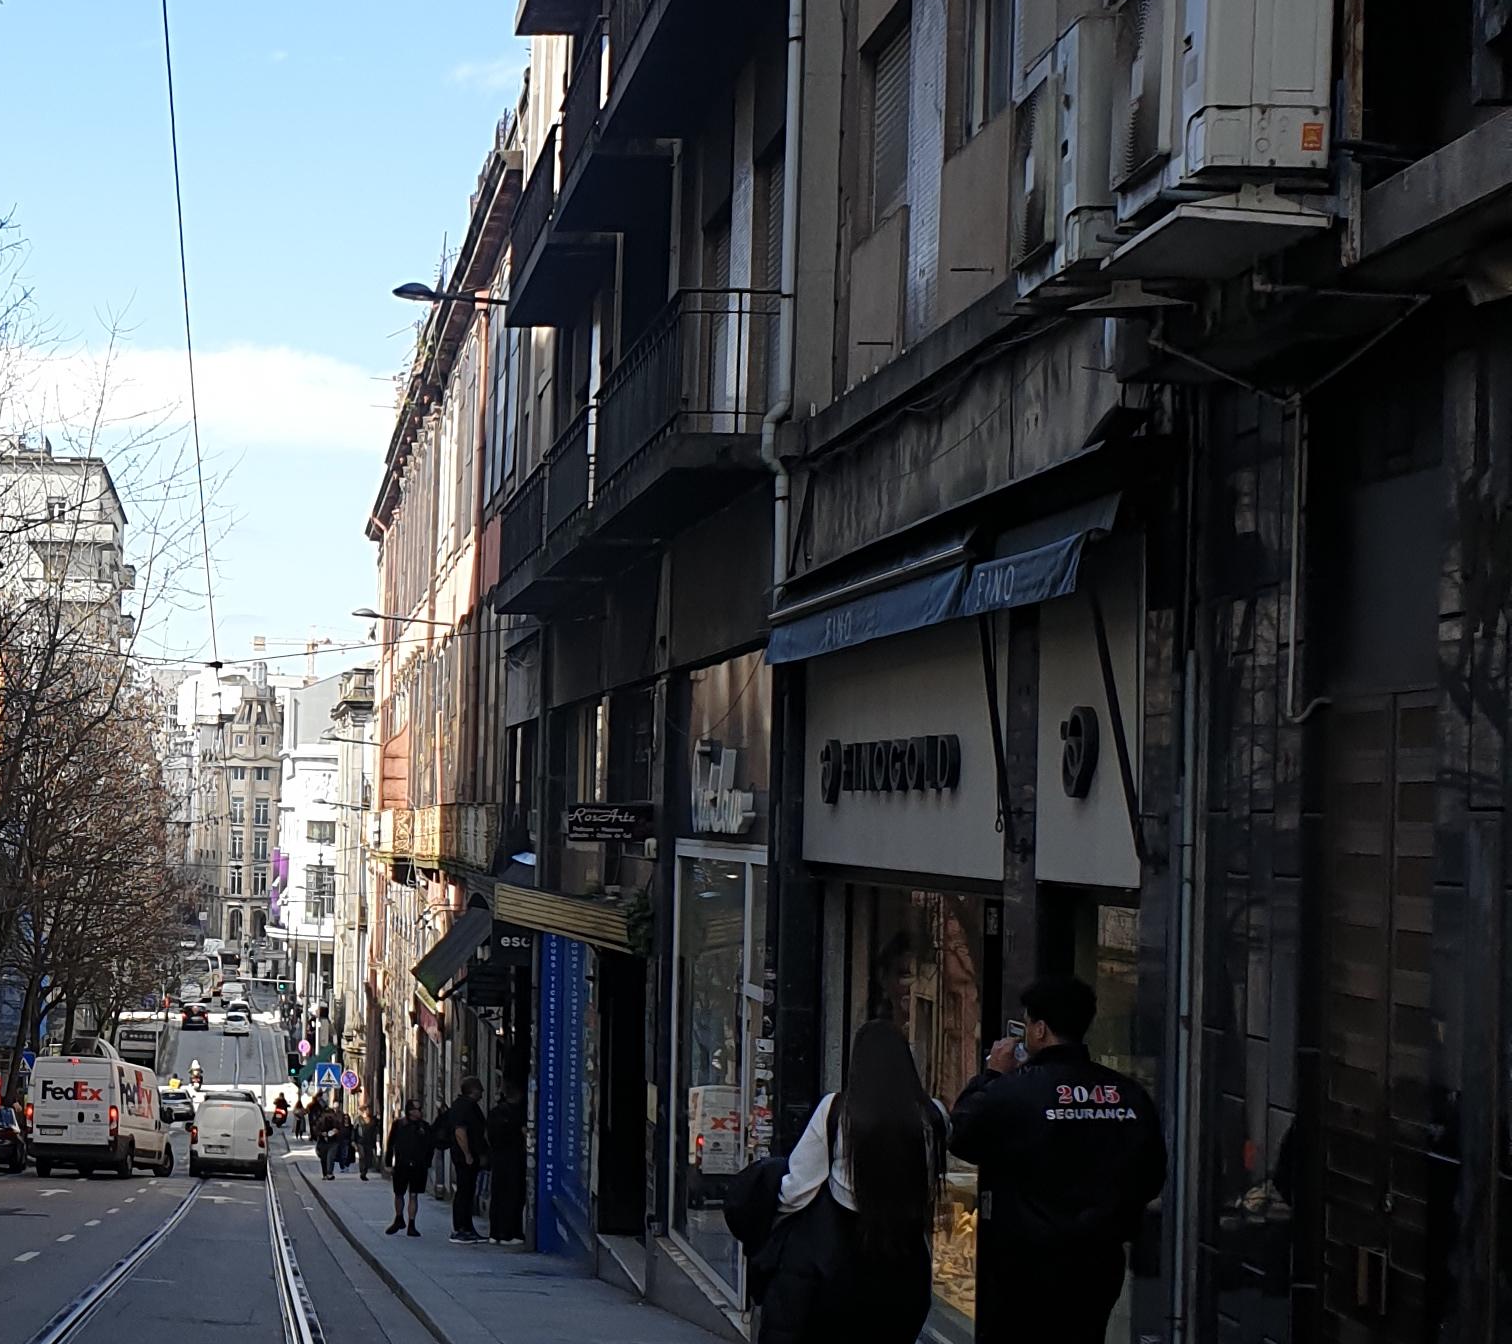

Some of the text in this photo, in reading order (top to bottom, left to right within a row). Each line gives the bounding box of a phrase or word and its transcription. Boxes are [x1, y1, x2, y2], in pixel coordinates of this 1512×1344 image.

[975, 564, 1015, 610] FINO
[821, 611, 853, 647] FINO
[840, 734, 961, 791] FINOGOLD
[41, 1080, 103, 1101] FedEx
[1056, 1084, 1121, 1104] 2045
[1045, 1107, 1137, 1123] SEGURANÇA
